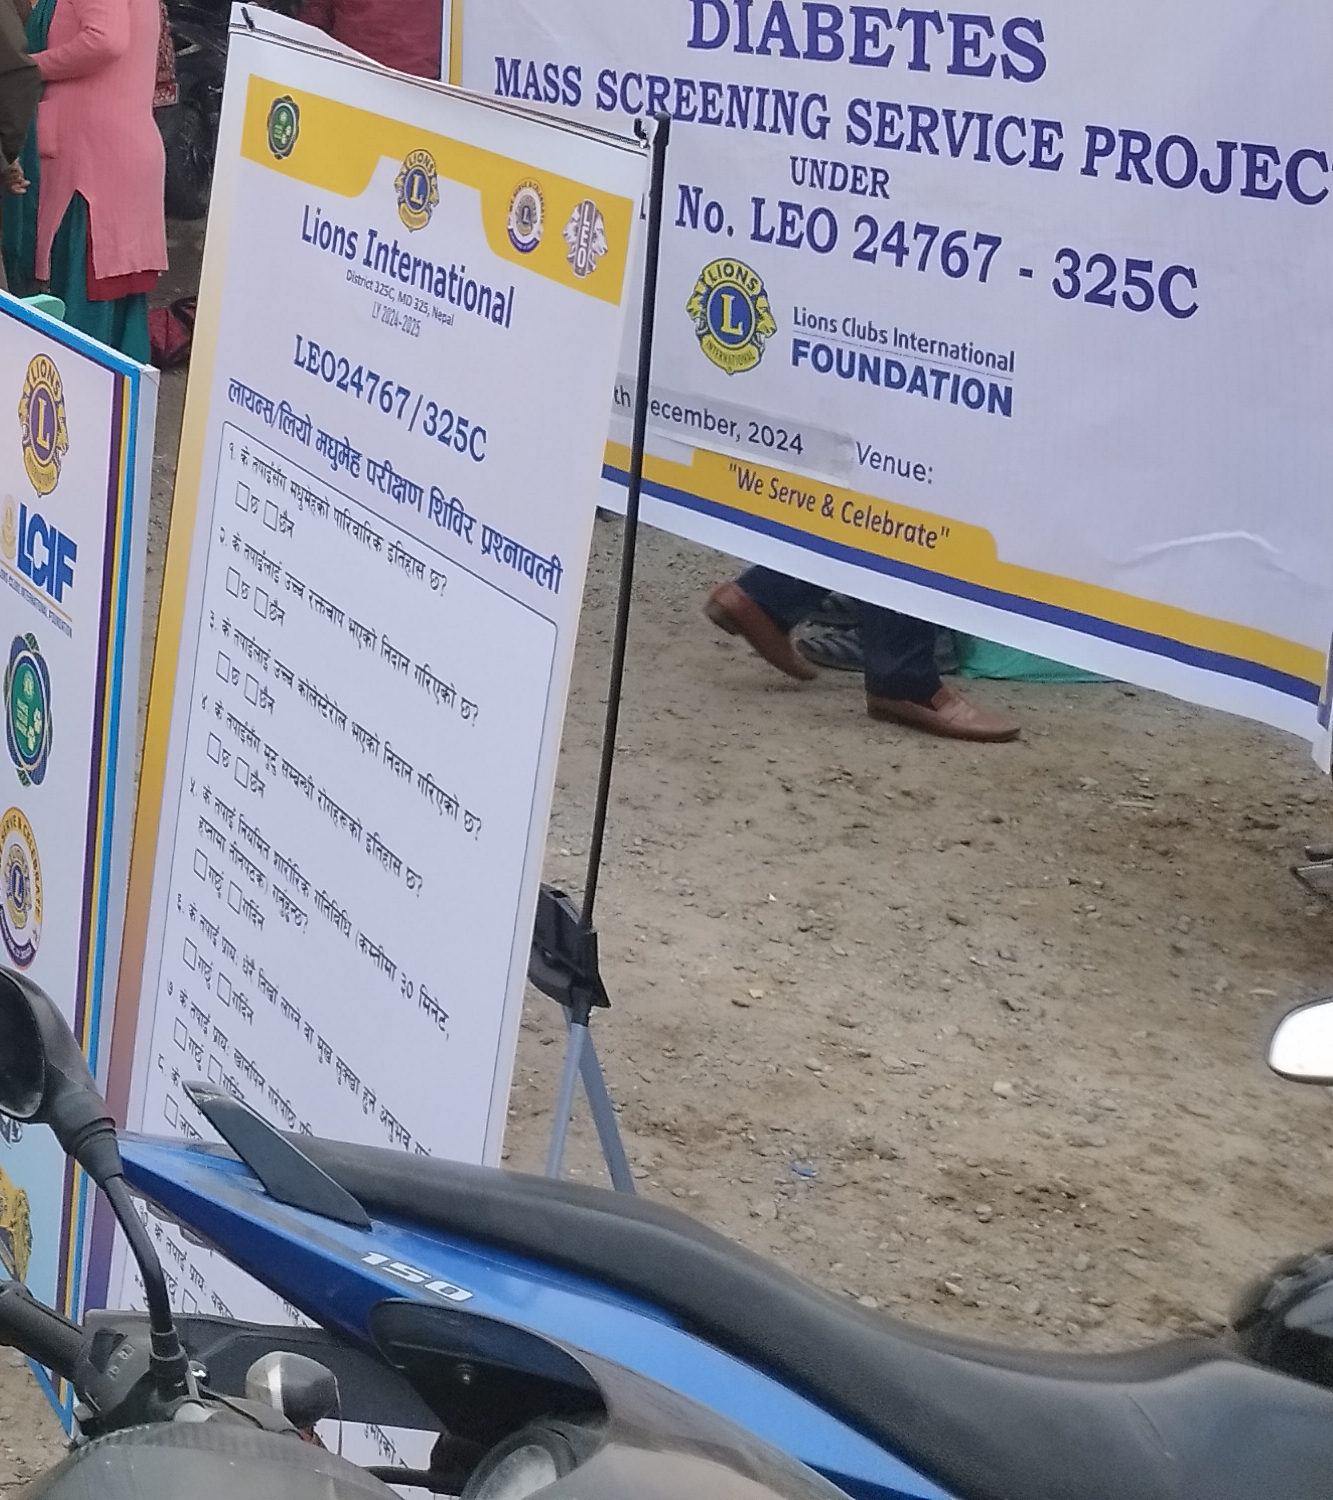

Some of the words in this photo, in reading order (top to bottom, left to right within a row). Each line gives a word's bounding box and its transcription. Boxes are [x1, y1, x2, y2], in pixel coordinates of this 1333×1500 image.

[493, 57, 582, 107] MASS
[595, 68, 831, 141] SCREENING
[846, 97, 1065, 172] SERVICE
[1080, 125, 1333, 207] PROJEC
[790, 156, 891, 200] UNDER
[301, 204, 358, 260] Lions
[363, 228, 515, 329] International
[675, 184, 735, 238] No.
[750, 196, 838, 254] LEO
[852, 214, 1003, 284] 24767
[1052, 248, 1200, 320] 325C
[707, 262, 759, 292] LIONS
[346, 269, 374, 291] District
[374, 280, 396, 302] 325C,
[397, 289, 413, 307] MD
[414, 297, 430, 317] 325,
[432, 306, 455, 327] Nepal
[720, 295, 744, 336] L
[794, 306, 838, 335] Lions
[842, 318, 889, 345] Clubs
[894, 327, 1015, 373] International
[29, 362, 63, 398] LIONS
[293, 333, 488, 463] LEO24767/325C
[792, 338, 1014, 418] FOUNDATION
[36, 395, 51, 451] L
[650, 397, 742, 442] ecember,
[748, 421, 804, 456] 2024
[227, 377, 314, 447] लायन्स/लियो
[315, 428, 364, 479] मधुमेह
[366, 457, 425, 514] परीक्षण
[427, 485, 478, 546] शिविर
[480, 523, 564, 595] प्रश्नावली
[856, 441, 933, 485] Venue:
[768, 477, 816, 513] Serve
[821, 493, 835, 519] &
[16, 502, 77, 604] LCIF
[361, 1250, 475, 1302] 150
